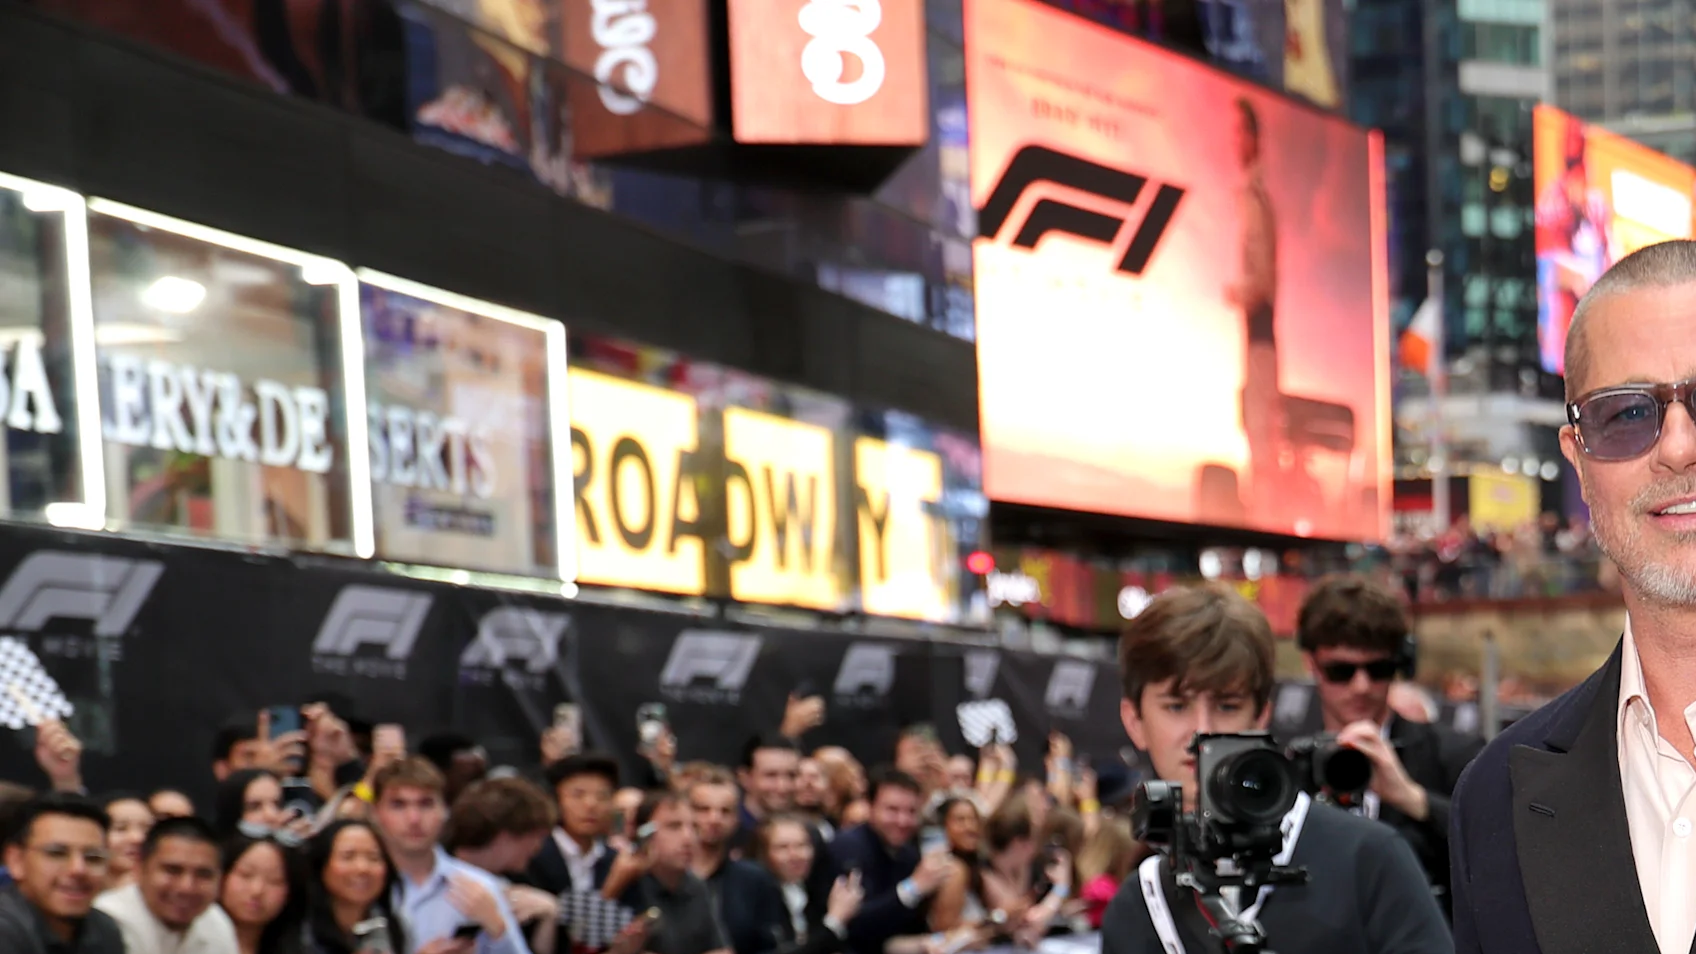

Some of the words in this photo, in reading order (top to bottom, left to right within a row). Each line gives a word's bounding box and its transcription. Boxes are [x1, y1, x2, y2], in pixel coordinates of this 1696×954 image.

[0, 338, 62, 434] A
[102, 354, 334, 472] ERY&DE
[571, 426, 896, 583] ROADWY
